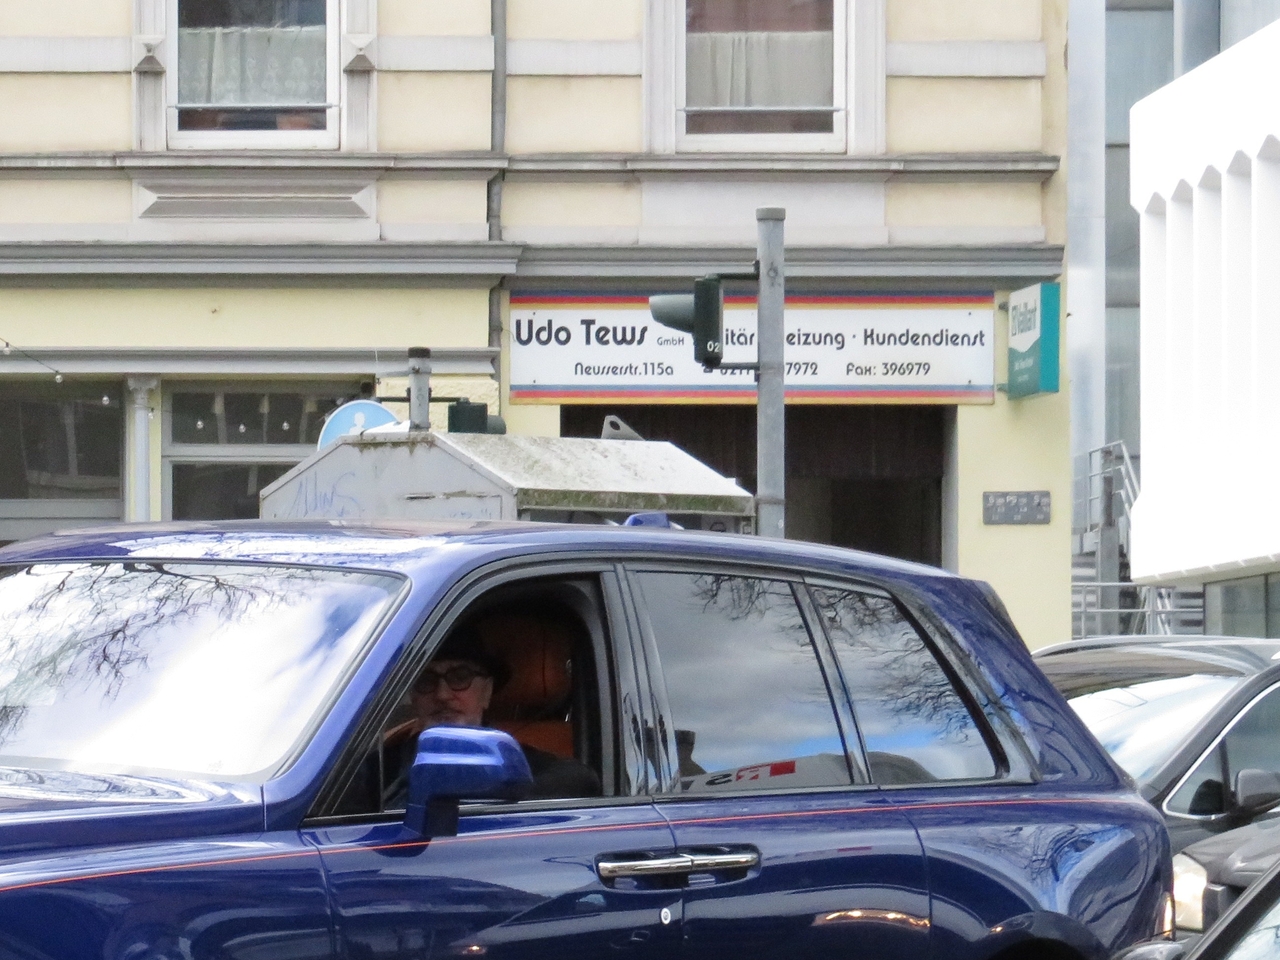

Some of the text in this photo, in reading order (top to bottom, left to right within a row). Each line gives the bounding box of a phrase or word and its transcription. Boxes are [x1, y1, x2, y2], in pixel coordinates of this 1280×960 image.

[515, 319, 985, 350] Udo Tews GmbH itär eizung Kundendienst
[574, 362, 931, 376] Neusserstr.115a 7972 Fax: 396979
